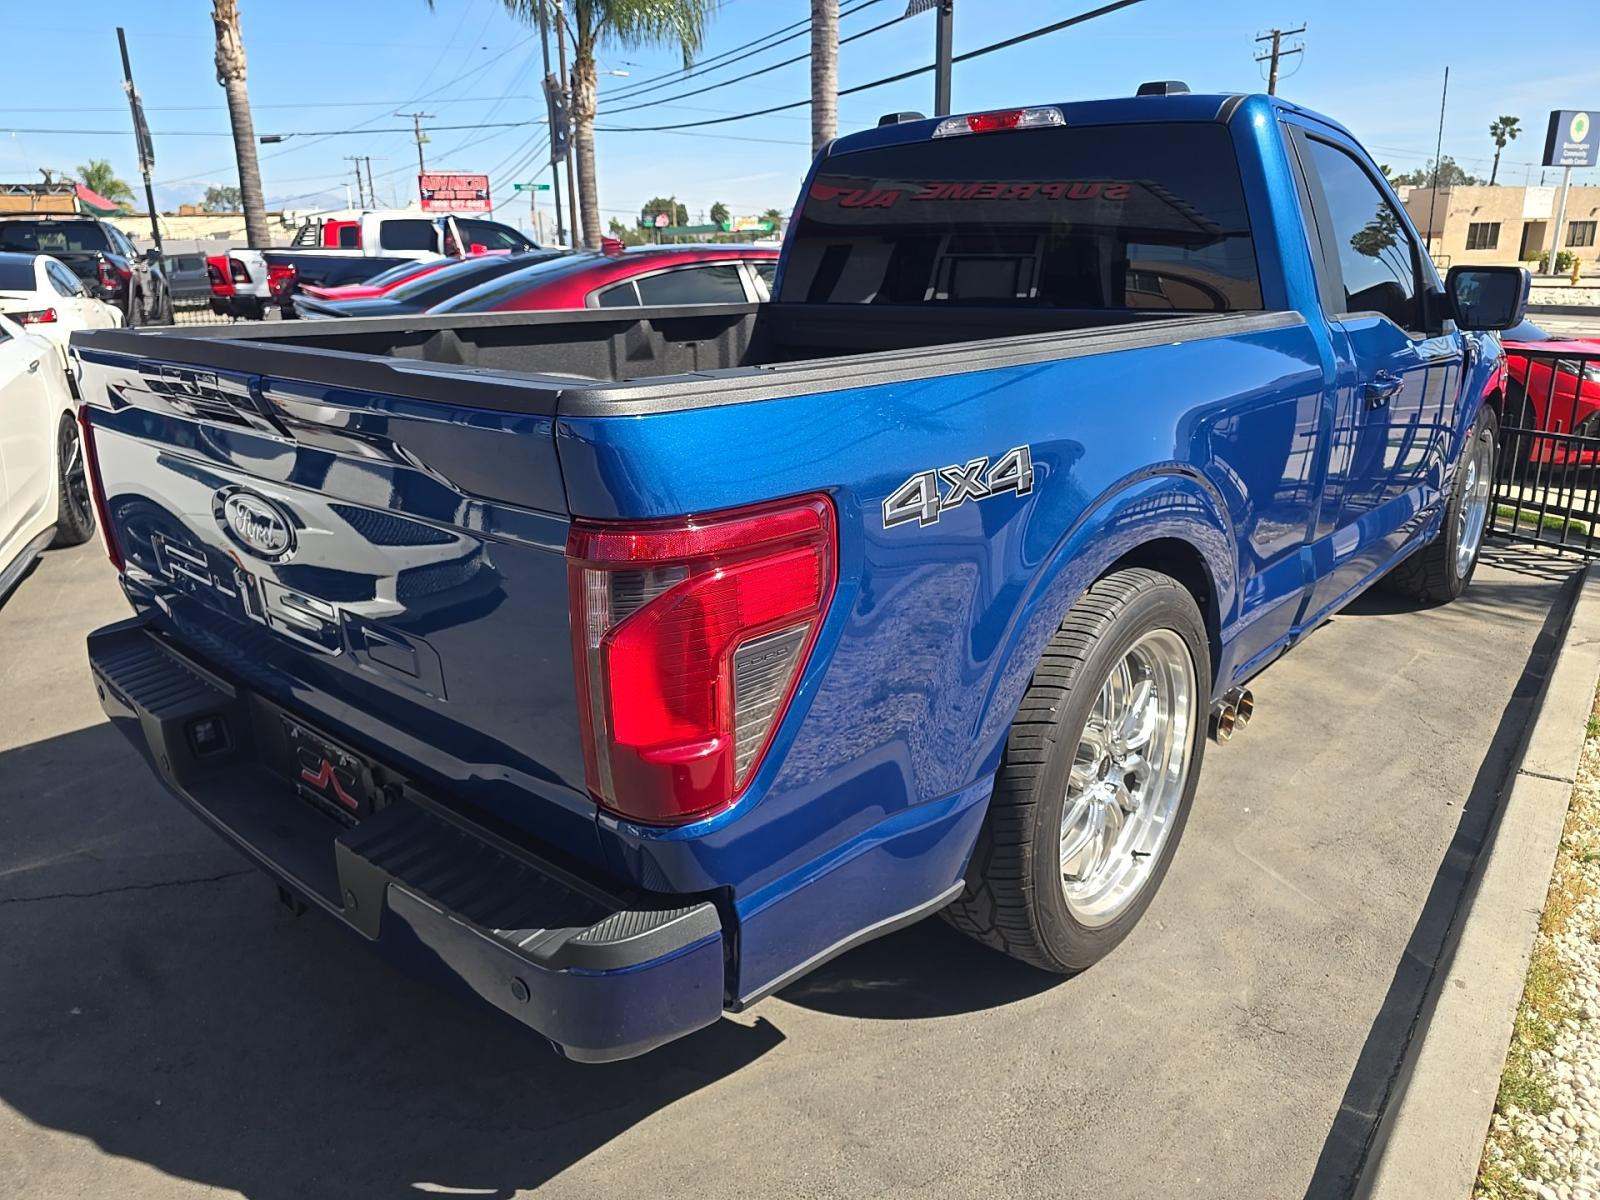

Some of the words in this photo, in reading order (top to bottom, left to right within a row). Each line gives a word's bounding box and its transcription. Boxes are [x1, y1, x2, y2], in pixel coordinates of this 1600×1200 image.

[235, 502, 280, 547] Ford
[150, 529, 448, 704] F-150
[737, 645, 789, 671] FORD
